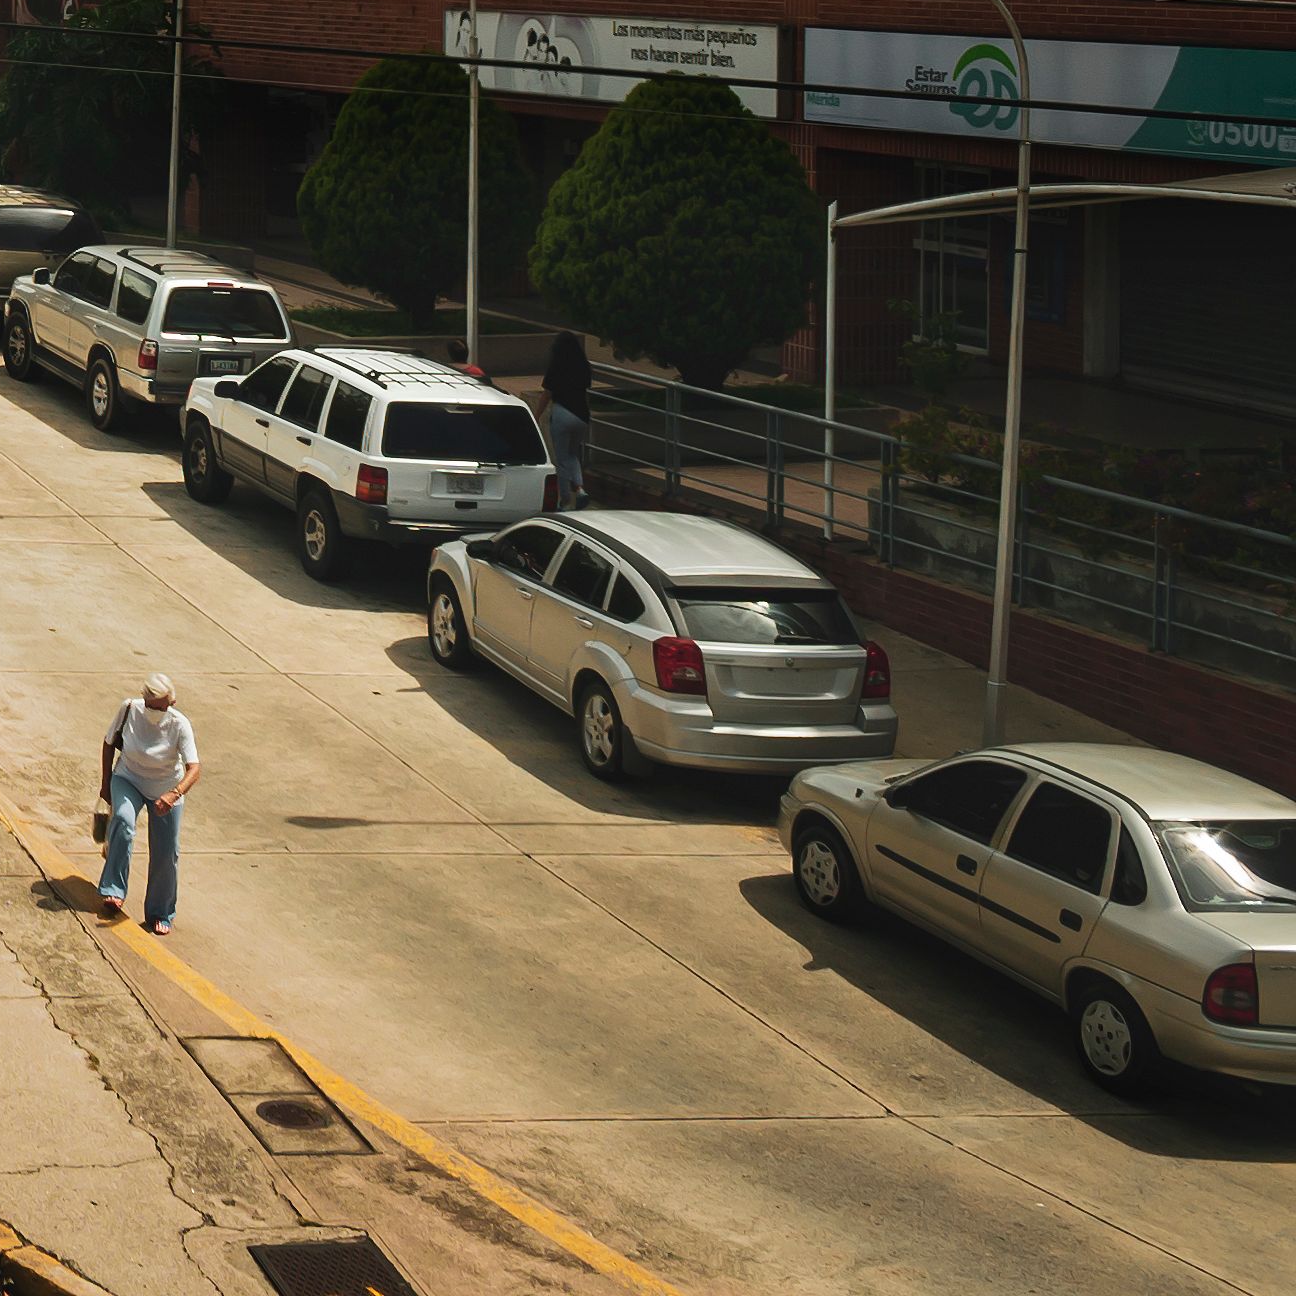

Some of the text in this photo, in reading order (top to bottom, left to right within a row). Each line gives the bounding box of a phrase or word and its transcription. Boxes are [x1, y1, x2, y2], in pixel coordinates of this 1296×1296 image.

[612, 20, 757, 49] Los momentos más pequeños
[630, 43, 736, 68] nos hacen sentir bien.
[914, 65, 949, 83] Estar
[1208, 119, 1277, 149] 0500
